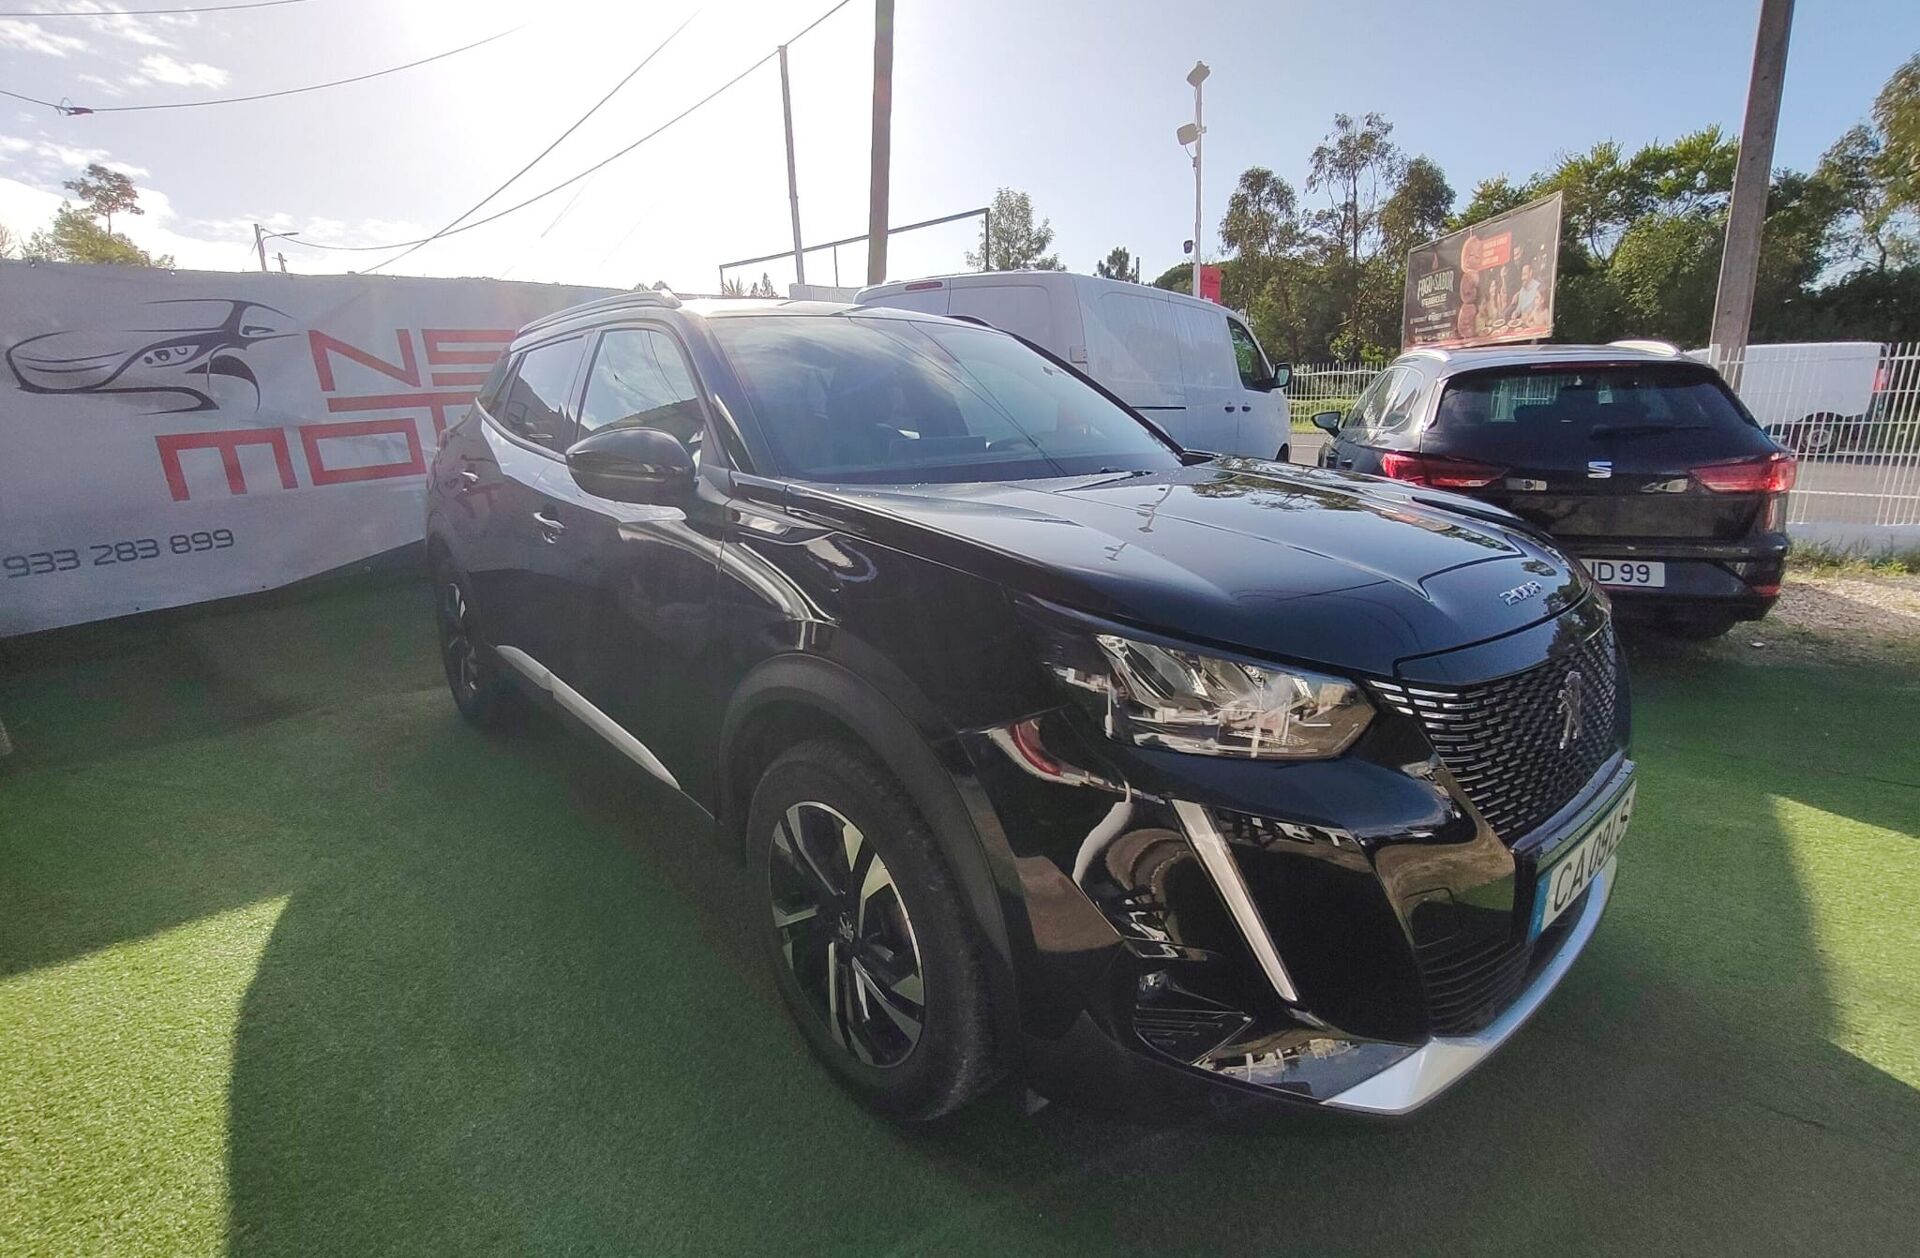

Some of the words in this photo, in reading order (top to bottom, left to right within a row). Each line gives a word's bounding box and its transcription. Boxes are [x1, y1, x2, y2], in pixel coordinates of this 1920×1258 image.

[3, 549, 81, 579] 933
[90, 538, 161, 567] 283
[169, 528, 235, 554] 899
[1620, 563, 1650, 583] 99
[1499, 580, 1542, 607] 2008
[1553, 848, 1586, 912] CA
